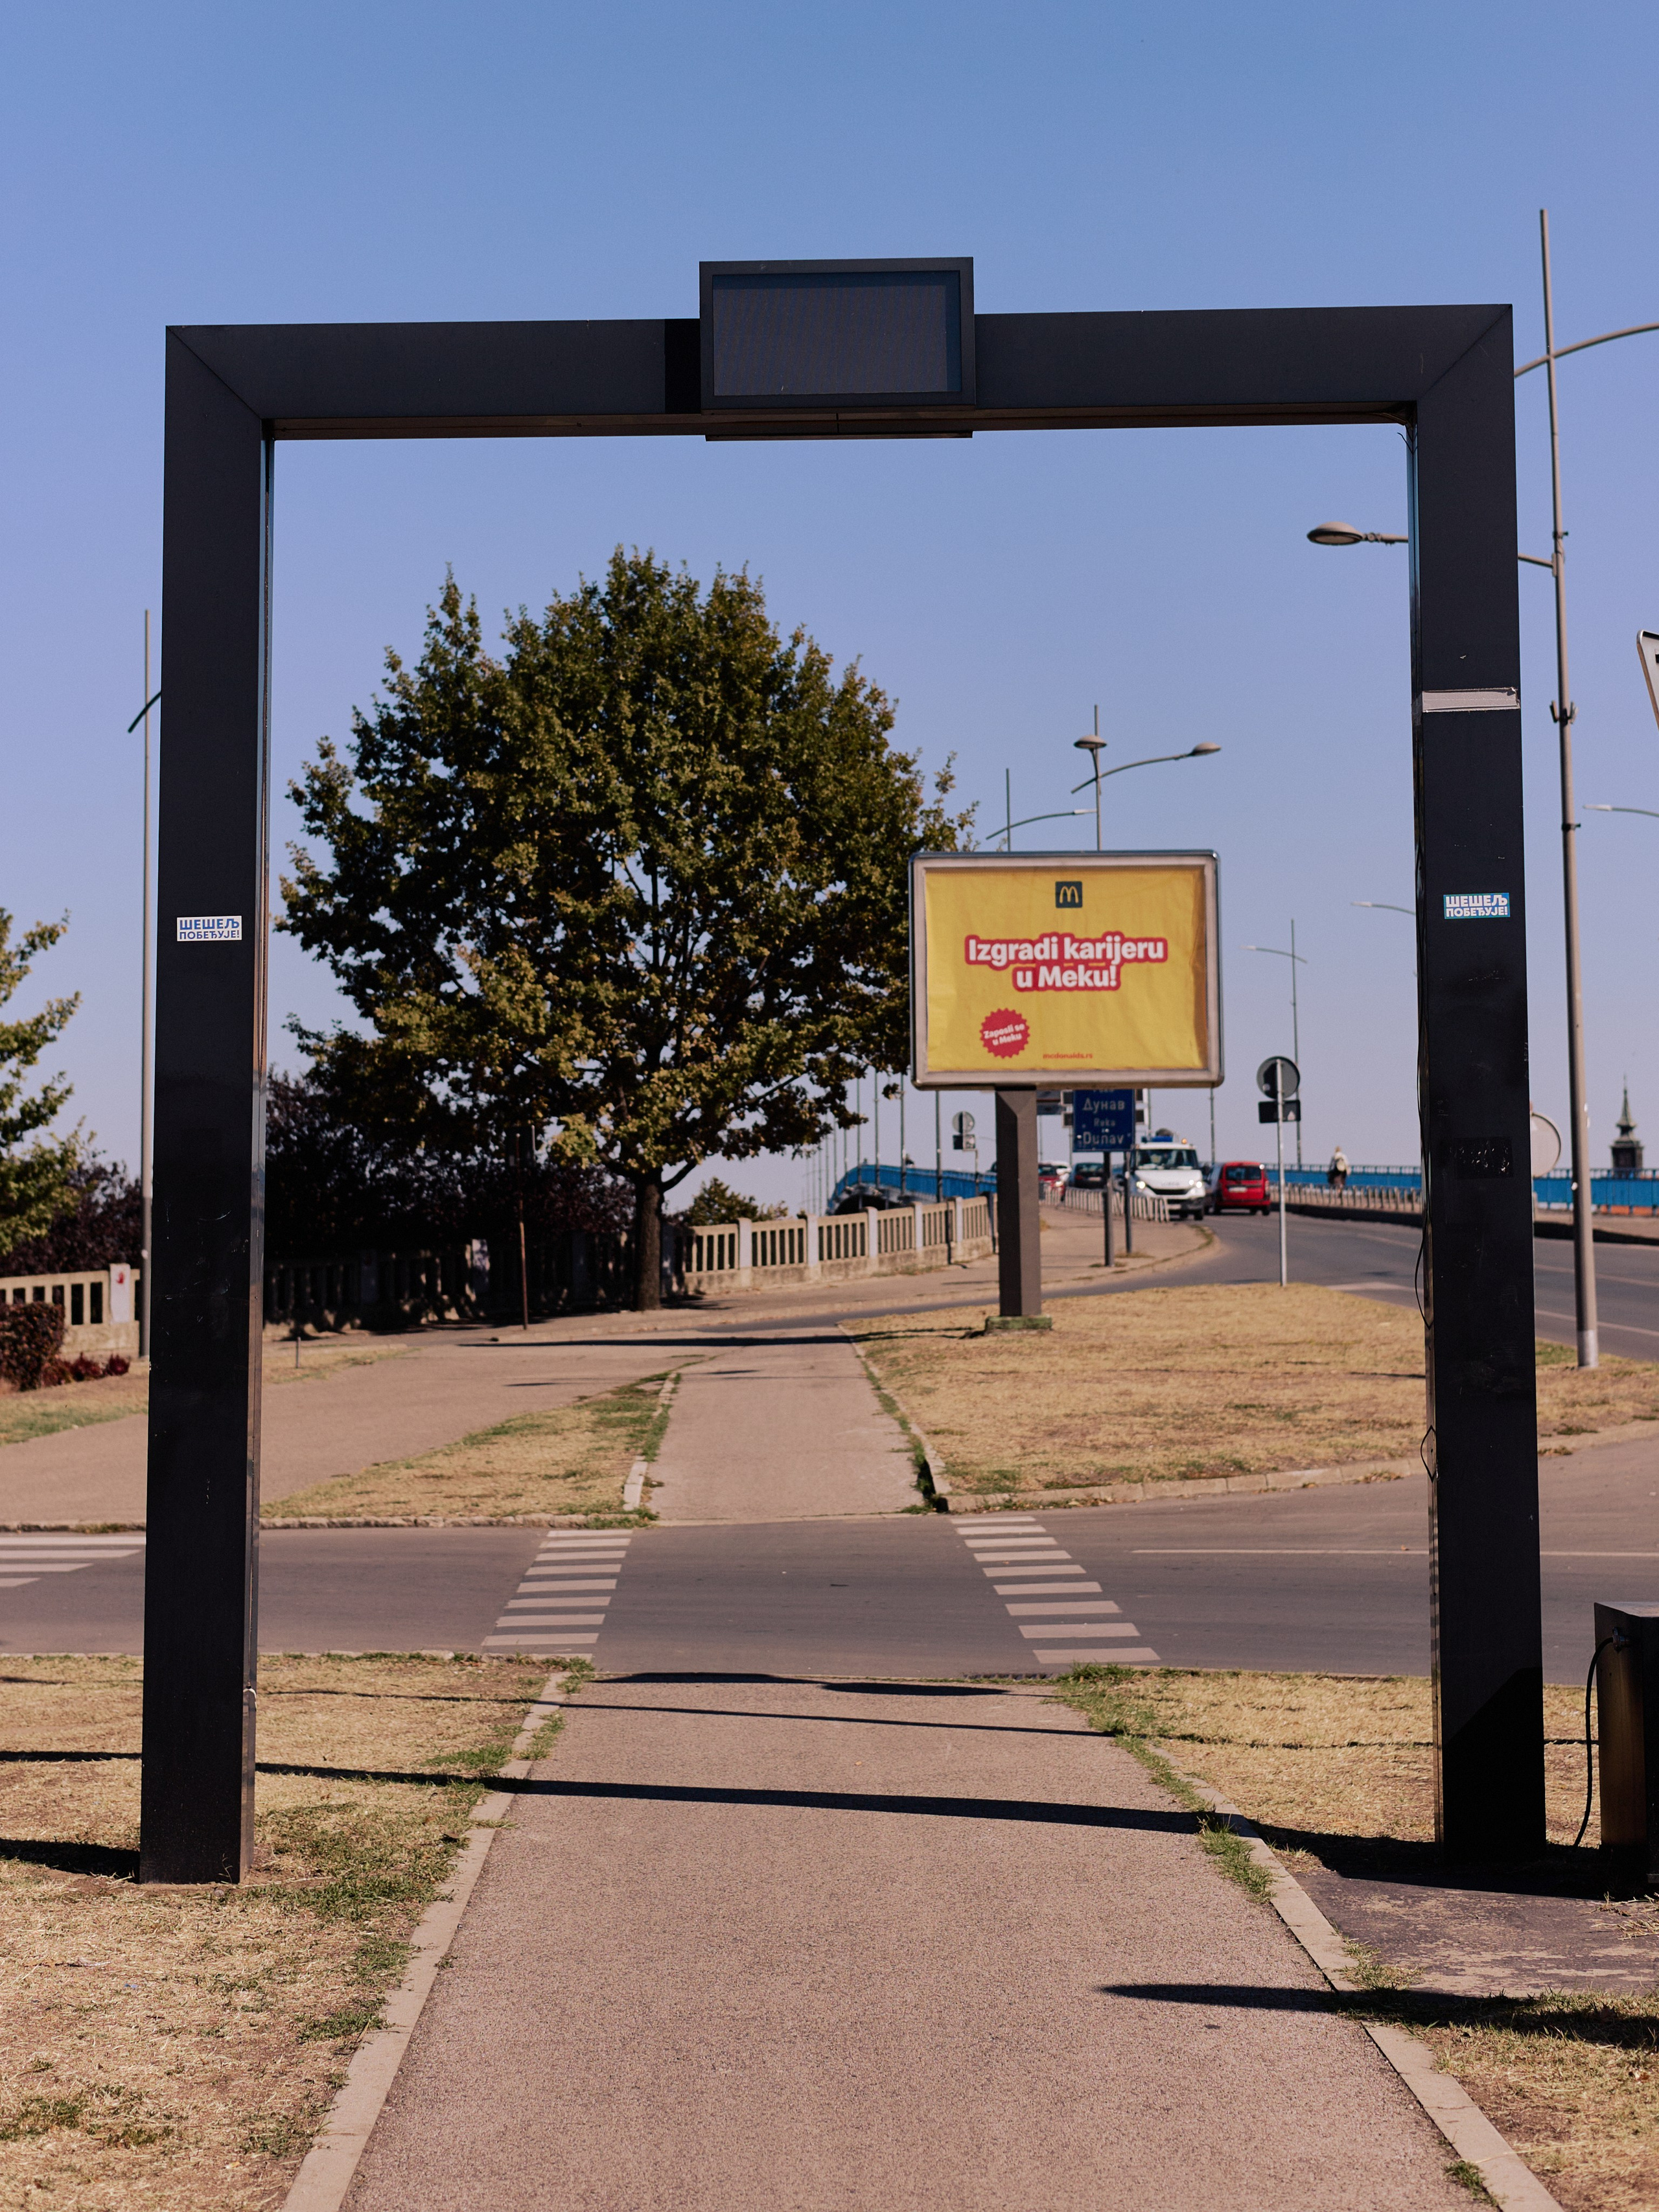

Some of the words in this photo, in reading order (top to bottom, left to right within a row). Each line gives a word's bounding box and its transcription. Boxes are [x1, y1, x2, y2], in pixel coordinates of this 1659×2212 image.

[1446, 894, 1508, 907] ШЕШЕЉ
[1446, 906, 1508, 917] ПОБЕЂУЈЕ!
[180, 918, 240, 930] ШЕШЕЉ
[180, 930, 240, 939] ПОБЕЂУЈЕ!
[969, 936, 1058, 966] Izgradi
[1064, 935, 1164, 965] karijeru
[1016, 970, 1032, 988] u
[1038, 964, 1117, 988] Meku!
[983, 1024, 1014, 1039] Zaposli
[999, 1033, 1023, 1044] Meku
[1082, 1097, 1125, 1113] Дунав
[1083, 1131, 1124, 1145] Dunav
